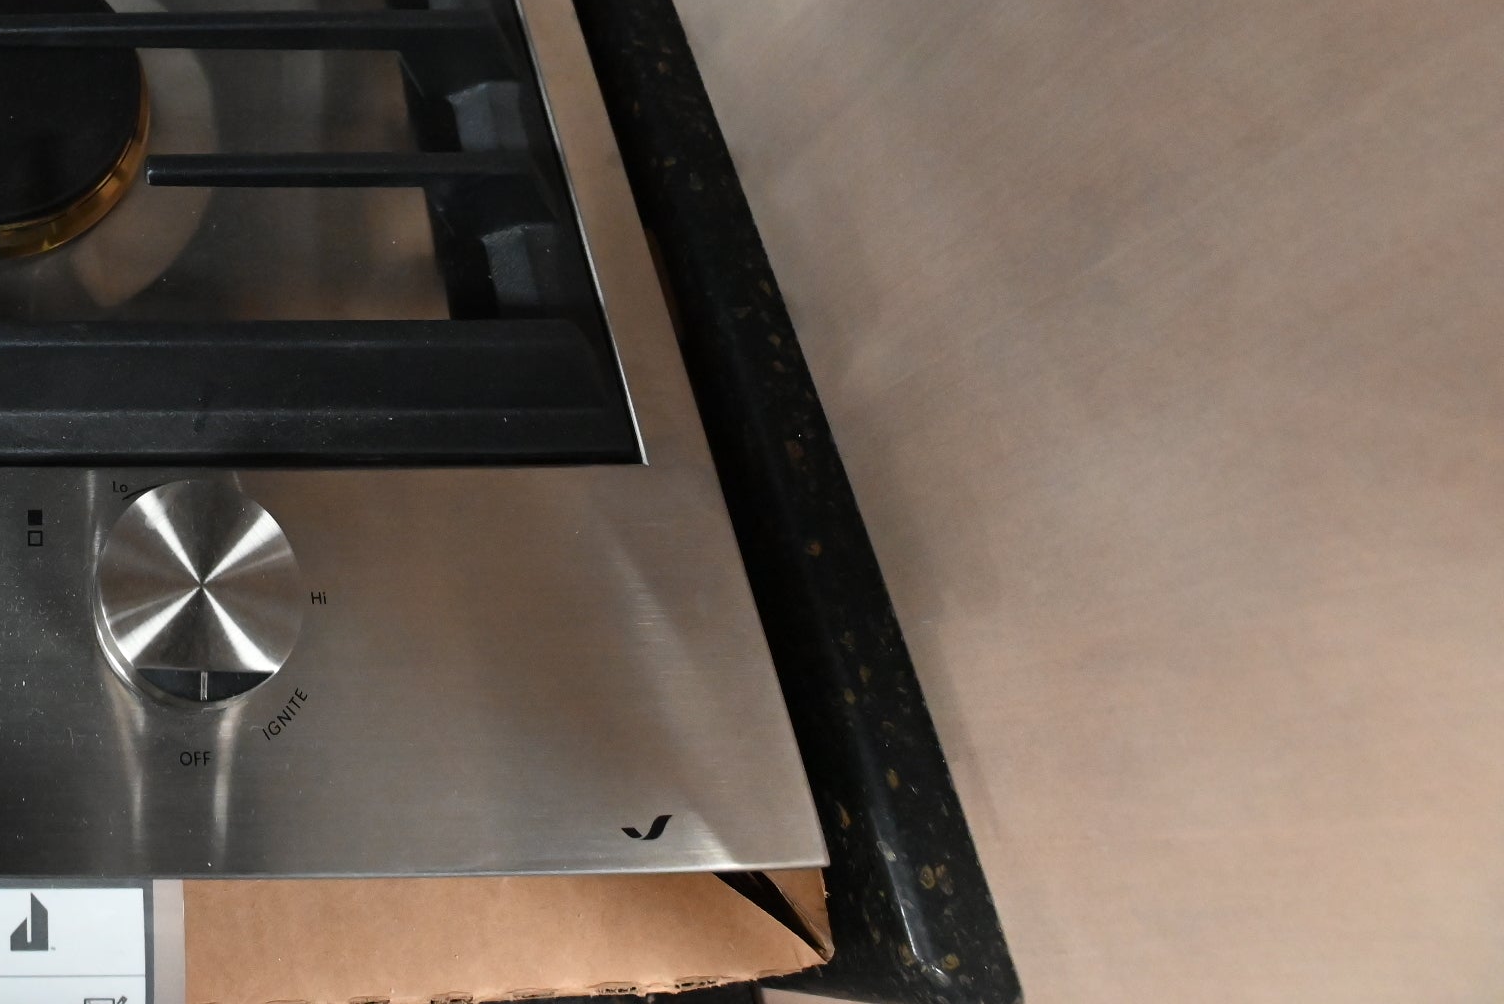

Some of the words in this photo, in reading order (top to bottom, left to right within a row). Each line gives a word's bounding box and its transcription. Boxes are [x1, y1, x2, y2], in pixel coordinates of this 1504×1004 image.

[111, 481, 129, 494] Lo
[310, 592, 327, 605] Hi
[262, 687, 308, 741] IGNITE
[179, 751, 212, 767] OFF
